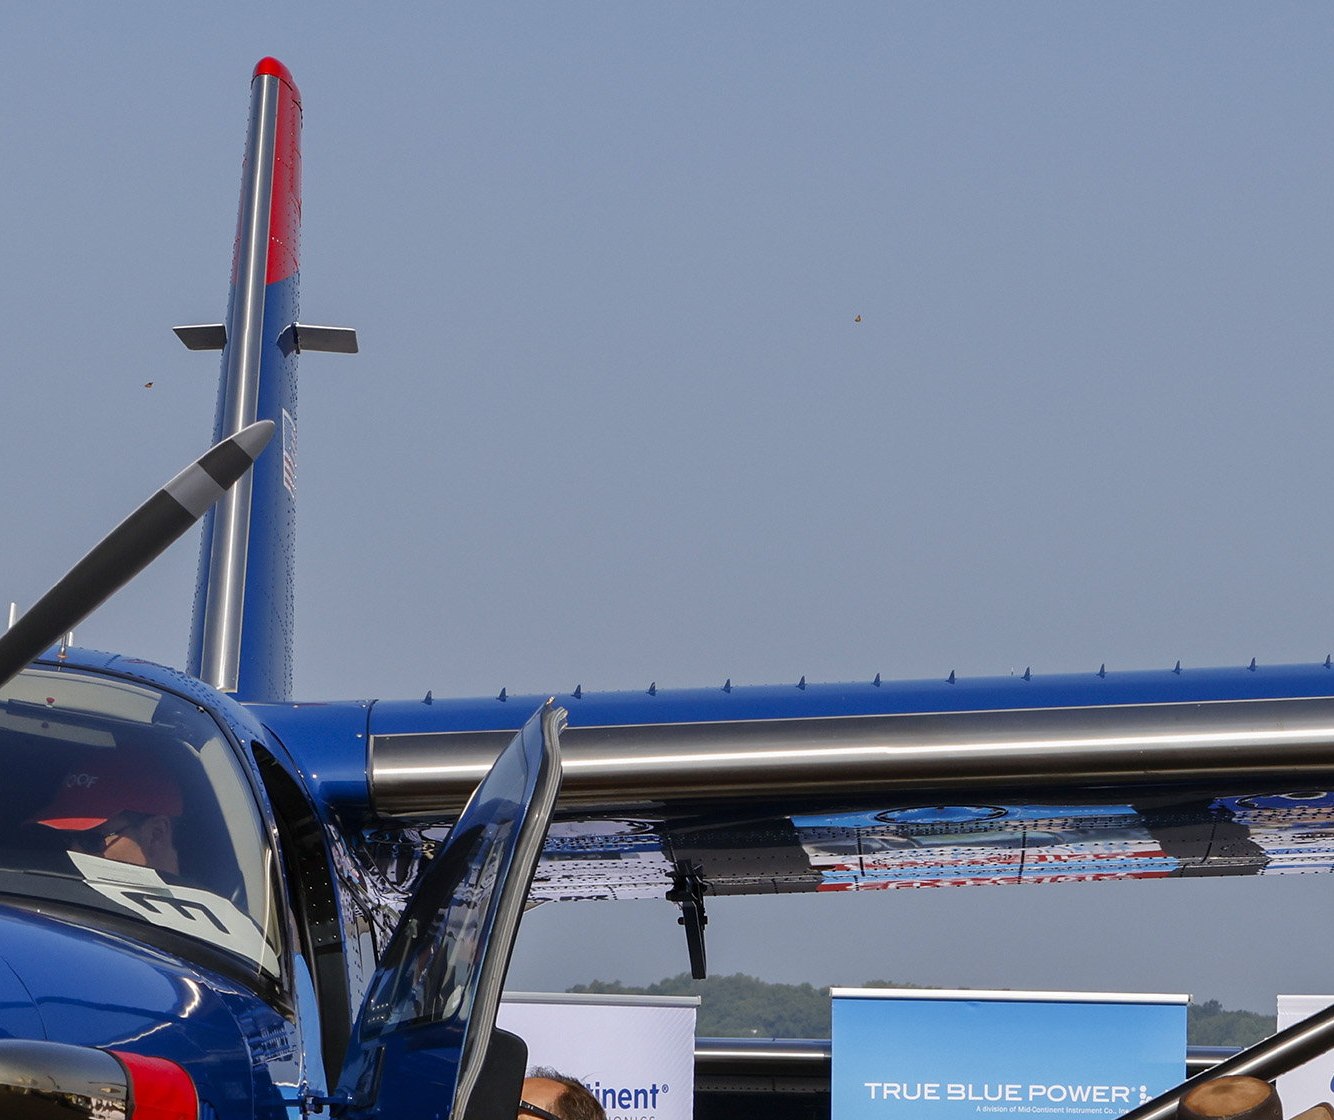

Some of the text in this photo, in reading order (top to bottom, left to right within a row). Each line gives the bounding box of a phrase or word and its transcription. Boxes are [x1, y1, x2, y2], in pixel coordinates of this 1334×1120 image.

[864, 1083, 940, 1100] TRUE
[947, 1084, 1022, 1101] BLUE
[982, 1105, 1008, 1113] division
[1009, 1105, 1017, 1113] of
[1018, 1106, 1065, 1114] Mid-Continent
[1066, 1107, 1103, 1115] Instrument
